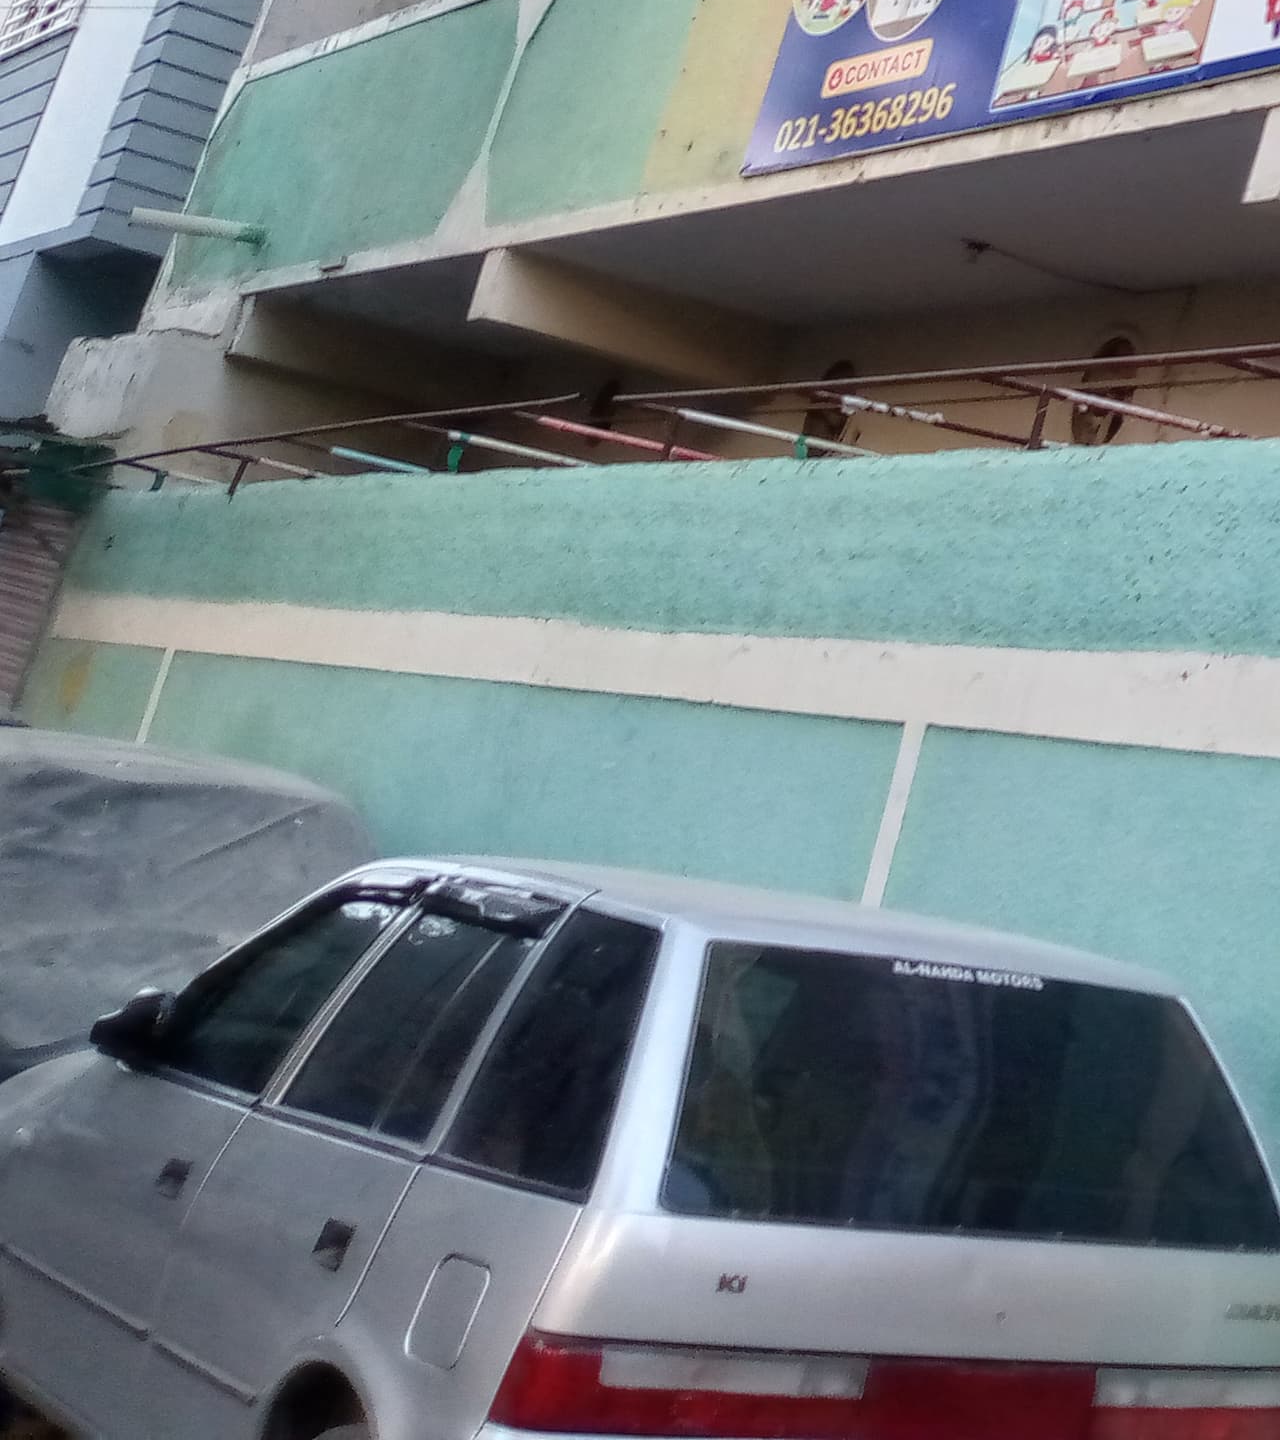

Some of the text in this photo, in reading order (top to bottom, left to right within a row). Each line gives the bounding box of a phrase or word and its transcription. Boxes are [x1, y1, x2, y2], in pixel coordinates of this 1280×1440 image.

[845, 46, 926, 86] CONTACT
[773, 83, 956, 154] 021-36368296
[975, 970, 1044, 991] MOTORS
